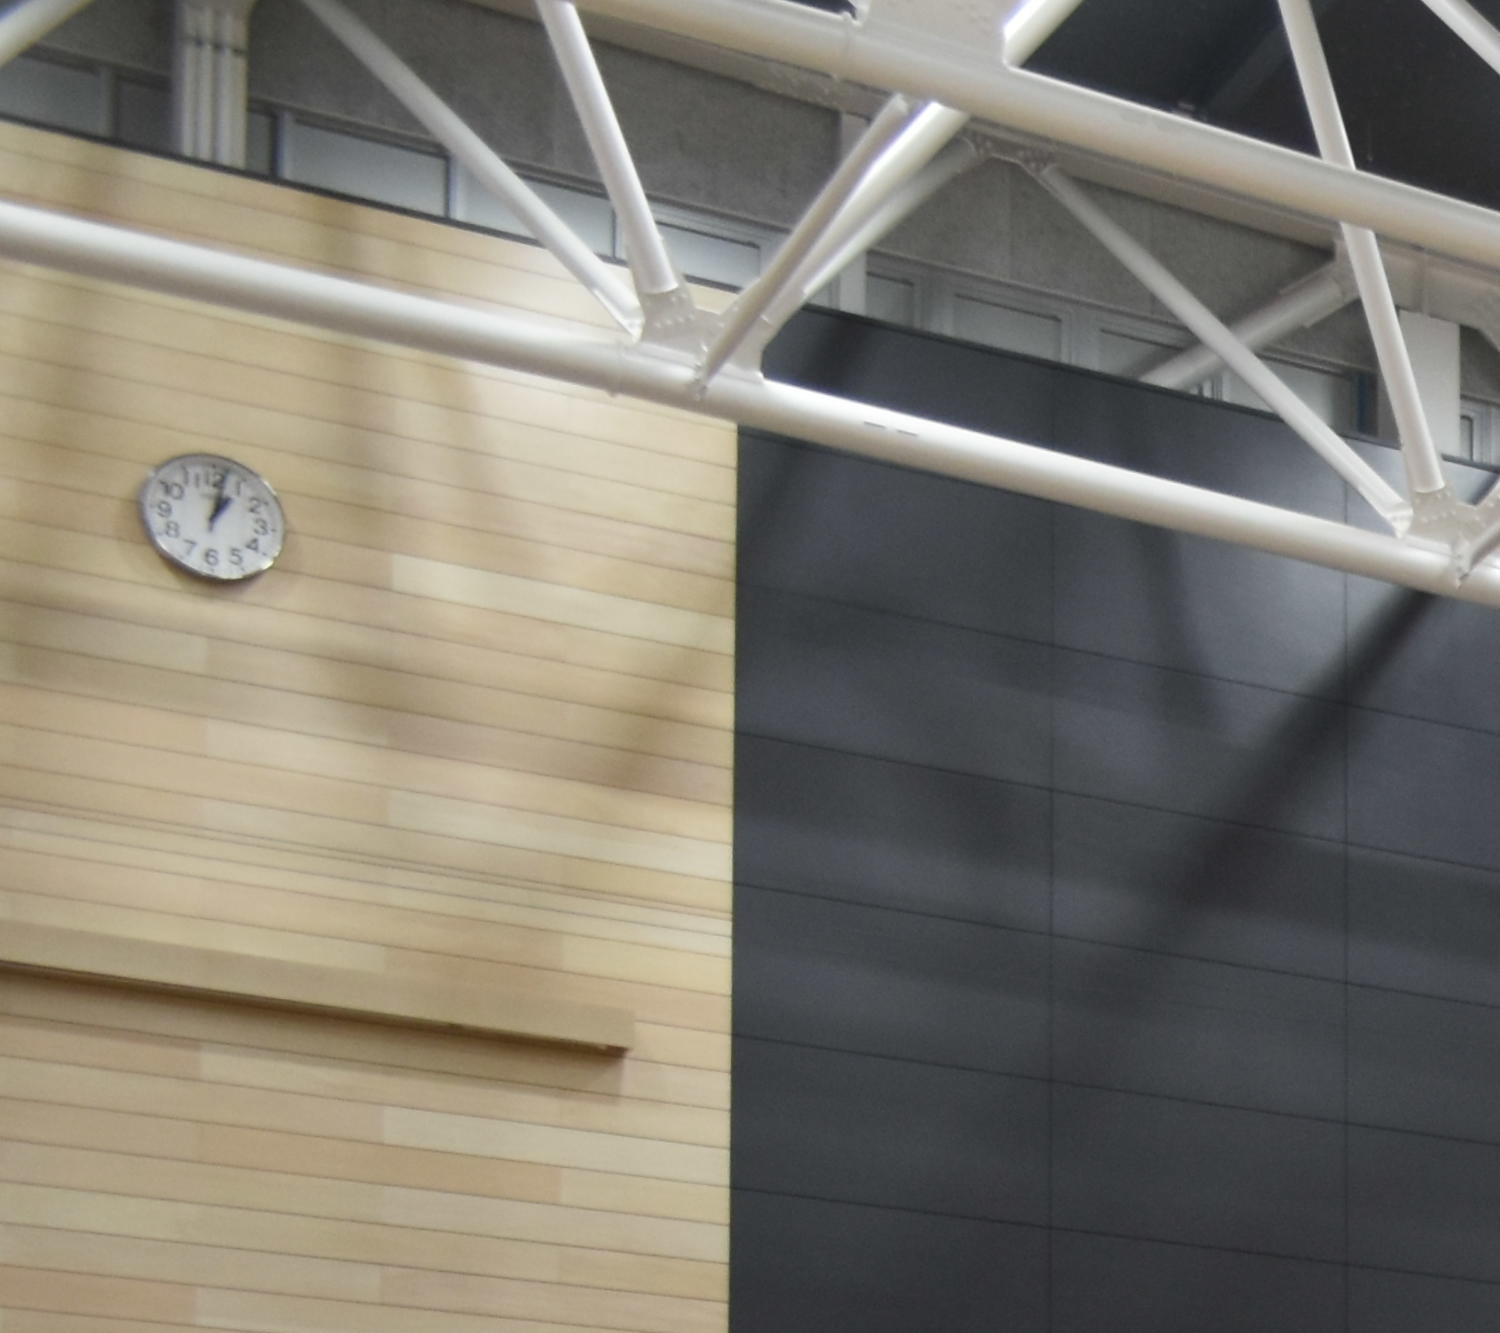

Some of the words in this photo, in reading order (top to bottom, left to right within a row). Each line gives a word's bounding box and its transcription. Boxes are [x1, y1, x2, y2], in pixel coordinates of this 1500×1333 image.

[181, 464, 200, 488] 11
[204, 472, 225, 489] 12
[159, 479, 185, 500] 10
[235, 477, 247, 496] 1
[156, 500, 172, 517] 9
[249, 497, 262, 514] 2
[166, 520, 180, 538] 8
[254, 518, 268, 536] 3
[183, 538, 197, 556] 7
[245, 537, 259, 552] 4
[204, 548, 219, 566] 6
[229, 548, 243, 565] 5
